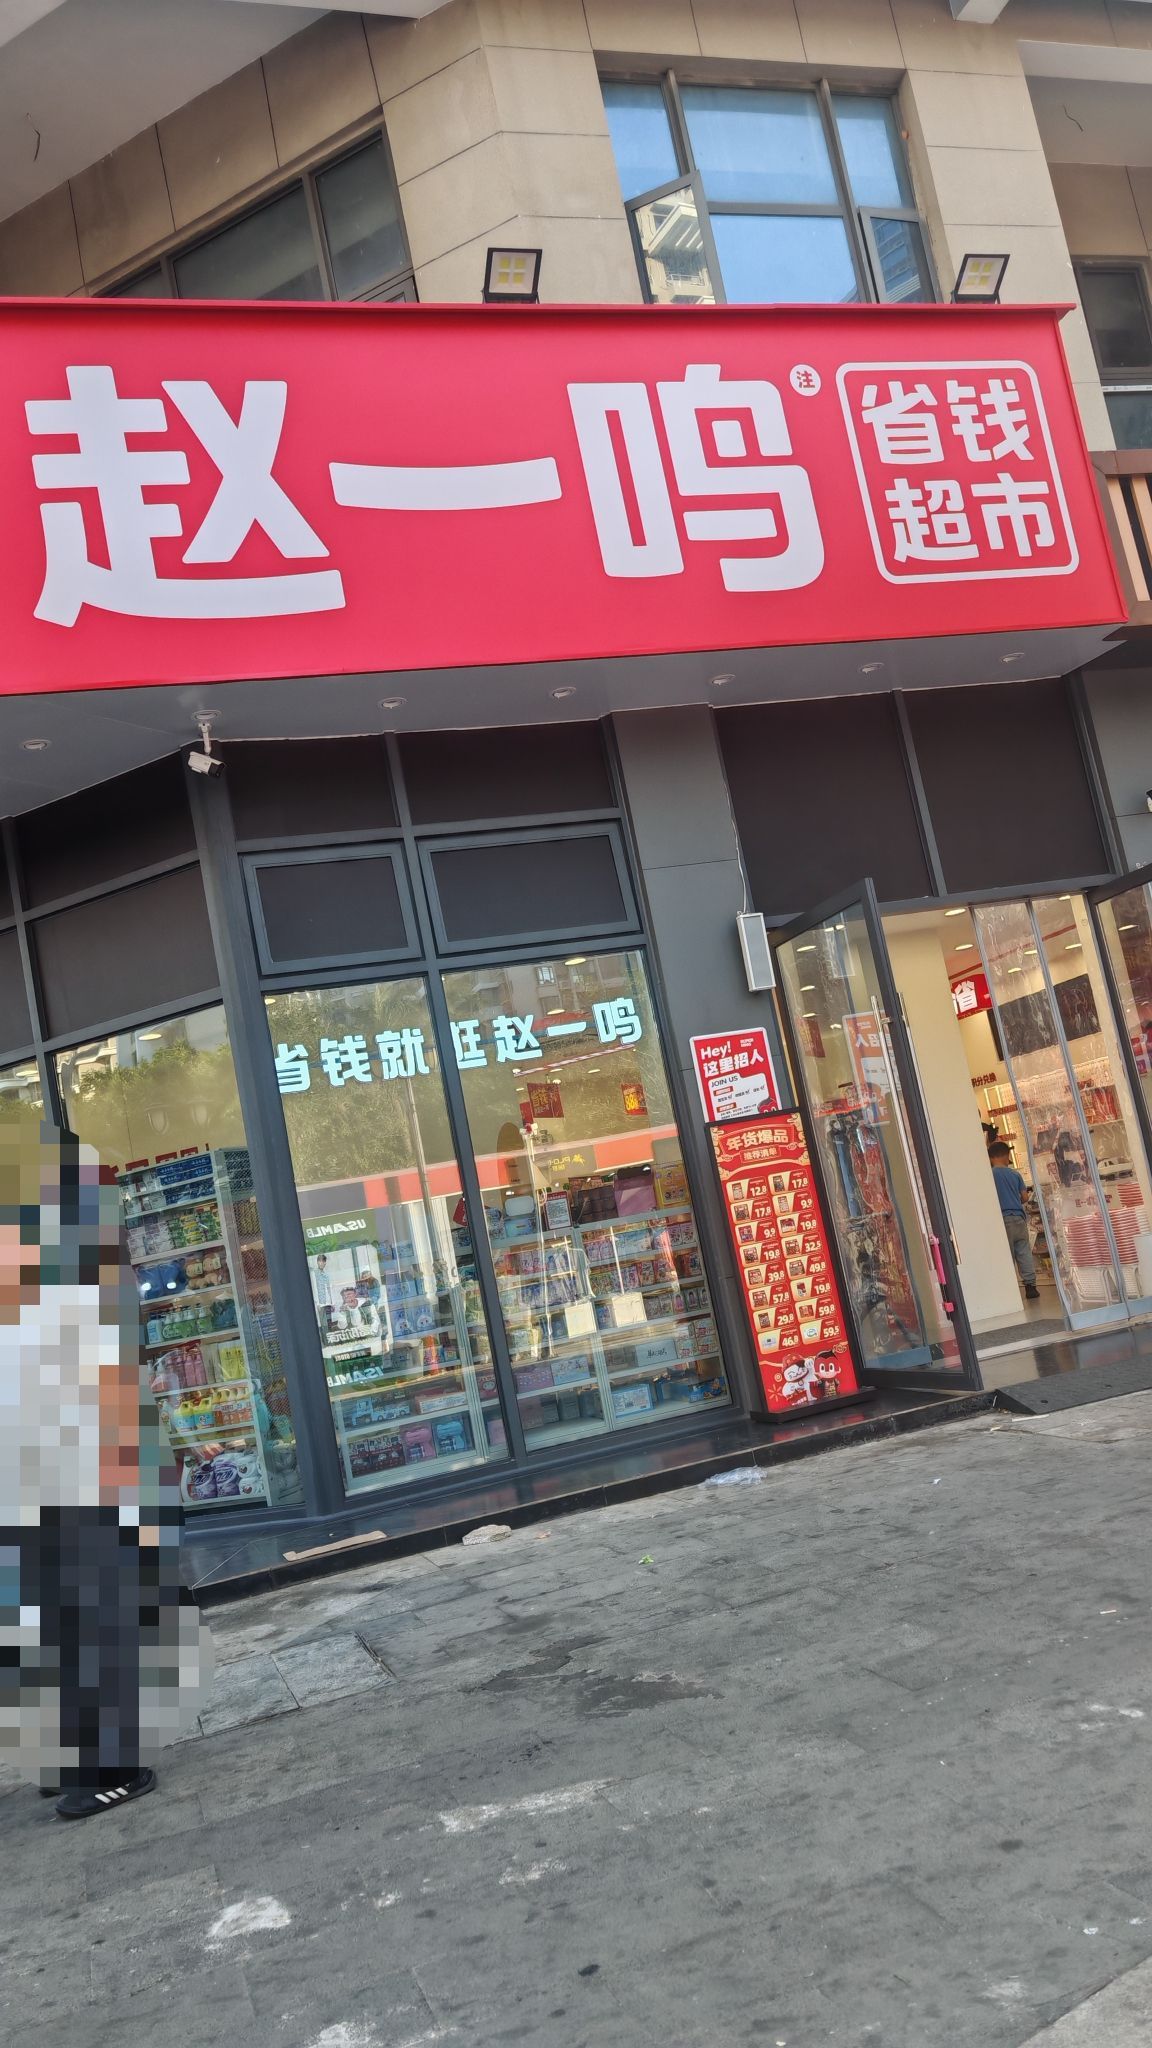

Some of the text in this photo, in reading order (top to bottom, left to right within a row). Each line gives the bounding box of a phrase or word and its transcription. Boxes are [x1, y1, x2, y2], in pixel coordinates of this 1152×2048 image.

[861, 378, 1034, 465] 省钱
[25, 364, 826, 628] 赵一鸣
[884, 472, 1056, 562] 超市
[700, 1040, 731, 1060] Hey!
[703, 1048, 764, 1078] 这里招人
[711, 1075, 739, 1088] JOIN US
[726, 1129, 789, 1150] 年货爆品
[743, 1147, 778, 1161] 推荐清单
[791, 1177, 809, 1189] 17.8
[750, 1185, 767, 1197] 12.8
[800, 1198, 813, 1209] 9.9
[754, 1206, 772, 1218] 17.8
[800, 1219, 817, 1231] 19.8
[763, 1228, 776, 1238] 9.9
[804, 1240, 822, 1252] 32.5
[763, 1249, 780, 1260] 19.8
[809, 1261, 826, 1273] 49.8
[767, 1270, 785, 1282] 39.8
[814, 1283, 831, 1294] 19.8
[772, 1292, 790, 1304] 57.8
[818, 1304, 835, 1316] 59.8
[777, 1313, 794, 1326] 29.8
[823, 1325, 840, 1338] 59.5
[782, 1335, 799, 1347] 46.8
